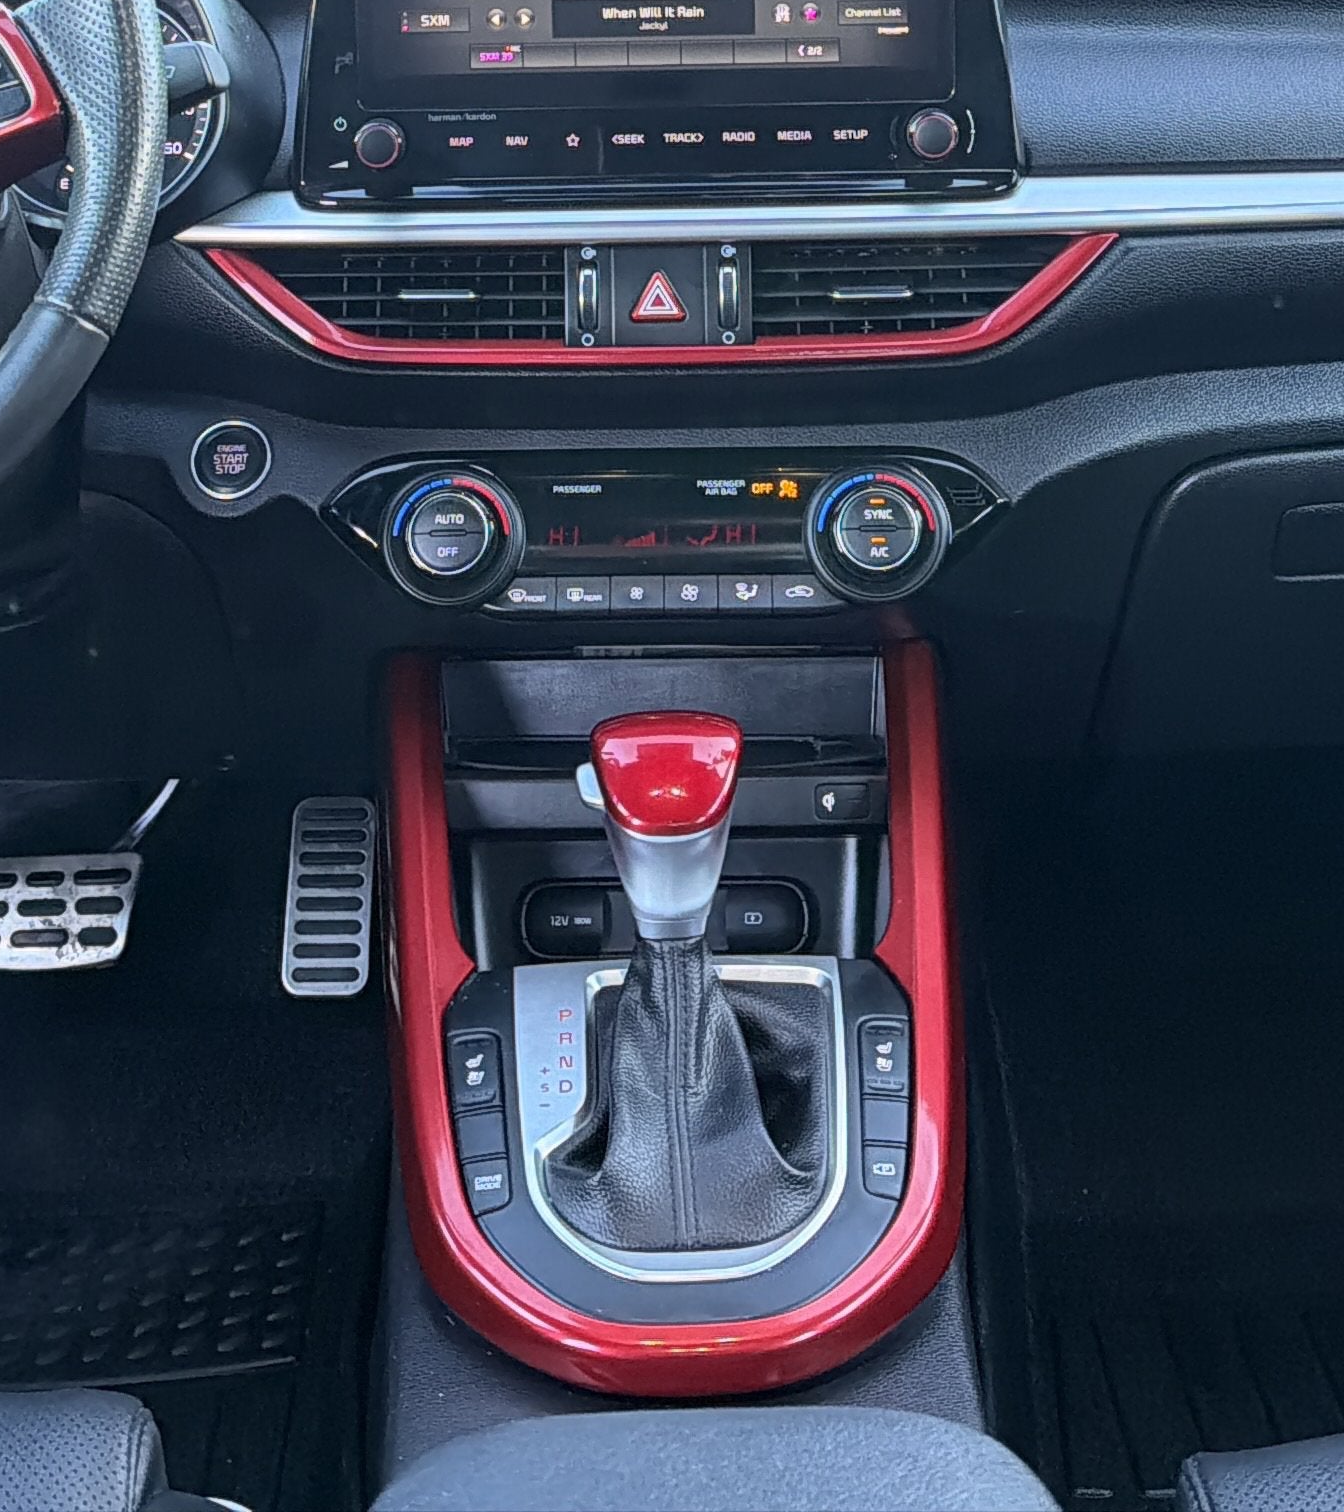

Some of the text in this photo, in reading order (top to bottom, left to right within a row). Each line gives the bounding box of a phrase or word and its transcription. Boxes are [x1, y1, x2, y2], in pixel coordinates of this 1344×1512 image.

[602, 5, 705, 19] When Will It Rain
[844, 7, 903, 18] Channel List
[420, 14, 451, 28] SXM
[722, 131, 756, 142] RADIO
[777, 130, 812, 141] MEDIA
[833, 129, 869, 140] SETUP
[449, 136, 474, 147] MAP
[505, 135, 529, 147] NAV
[59, 178, 70, 190] E
[216, 444, 247, 453] ENGINE
[213, 453, 249, 464] START
[215, 463, 246, 475] STOP
[552, 484, 603, 494] PASSENGER
[696, 479, 745, 489] PASSENGER
[751, 482, 774, 495] OFF
[705, 487, 738, 496] AIR BAG
[434, 513, 464, 525] AUTO
[863, 508, 893, 520] SYNC
[436, 546, 459, 558] OFF
[869, 546, 890, 558] A/C
[523, 594, 547, 603] FRONT
[583, 593, 603, 602] REAR
[550, 915, 569, 926] 12V
[559, 1009, 573, 1022] P
[559, 1032, 573, 1045] R
[559, 1055, 573, 1068] N
[559, 1080, 573, 1093] D
[474, 1173, 503, 1184] DRIVE
